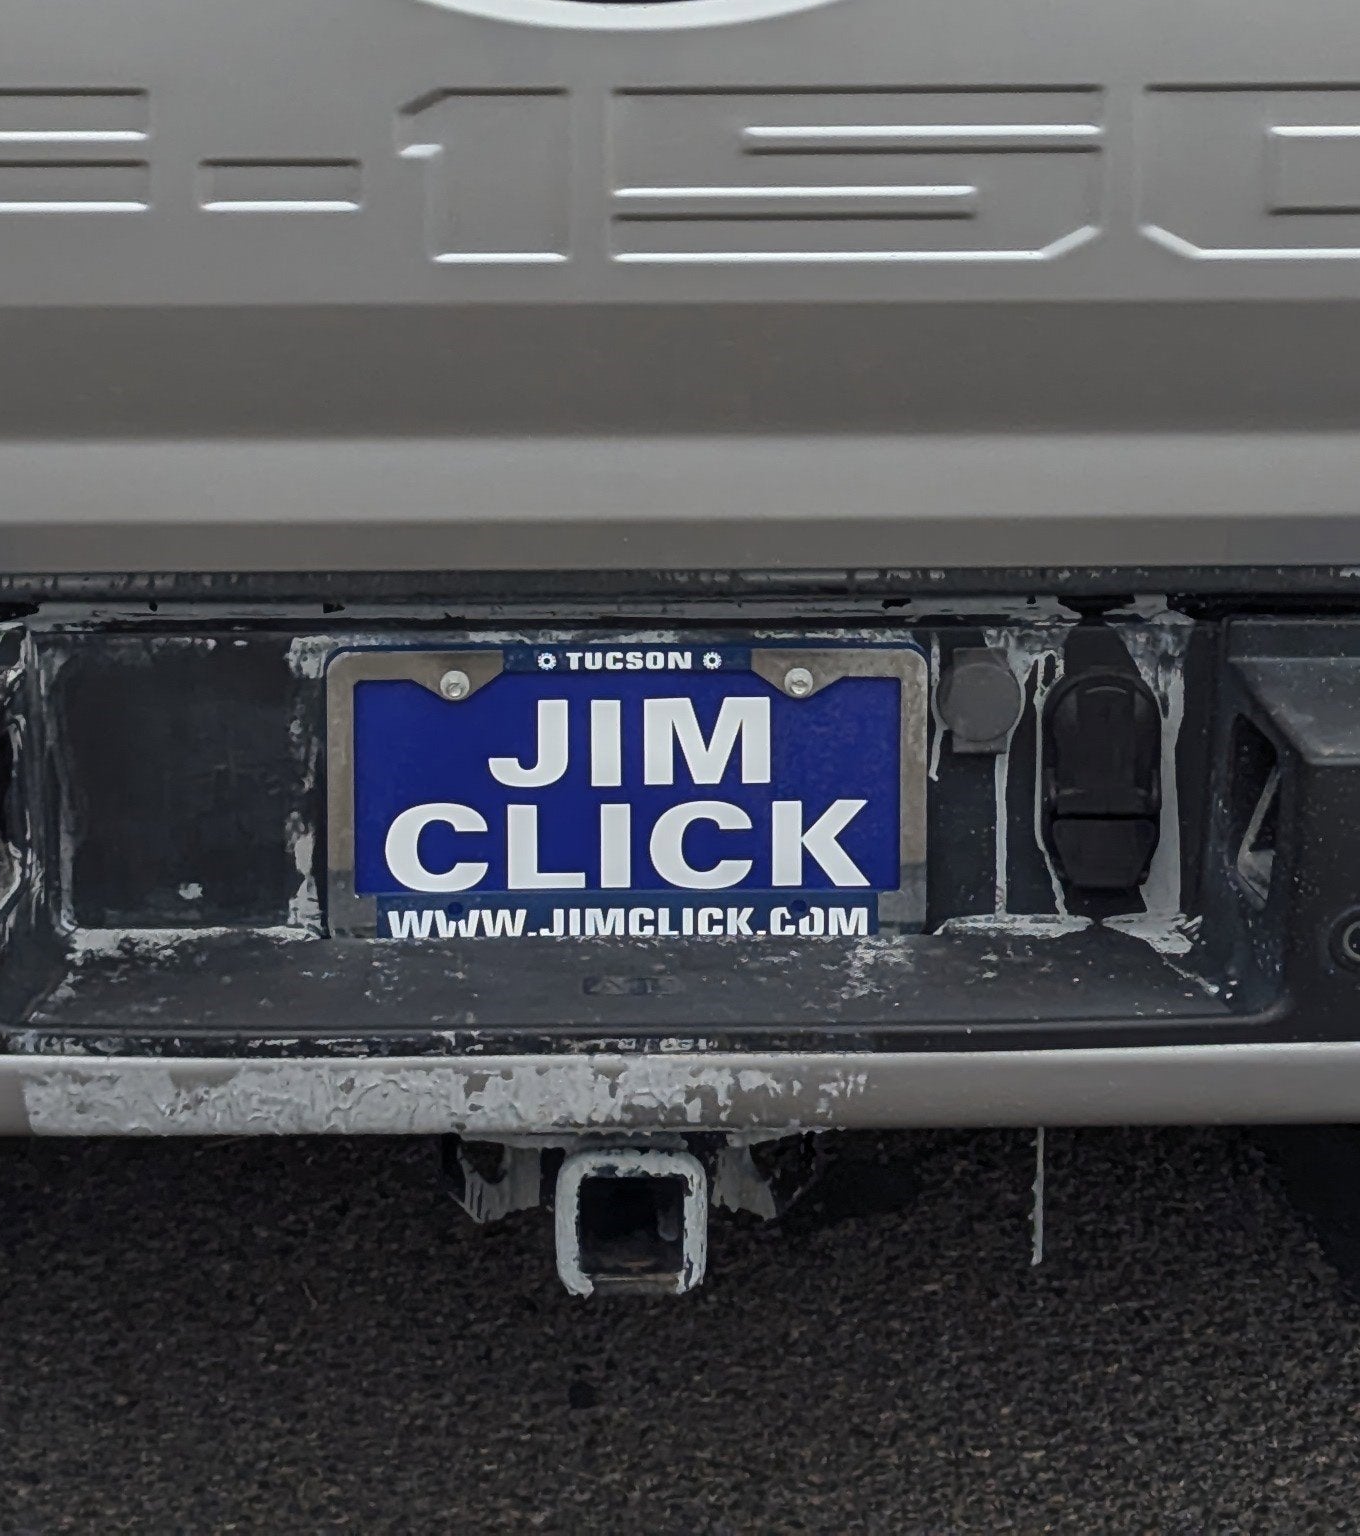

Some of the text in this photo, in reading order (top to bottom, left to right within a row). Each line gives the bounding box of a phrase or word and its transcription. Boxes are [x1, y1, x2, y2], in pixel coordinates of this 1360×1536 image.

[565, 650, 693, 671] TUCSON
[487, 695, 772, 788] JIM
[384, 798, 872, 893] CLICK
[387, 906, 870, 938] WWW.JIMCLICK.COM
